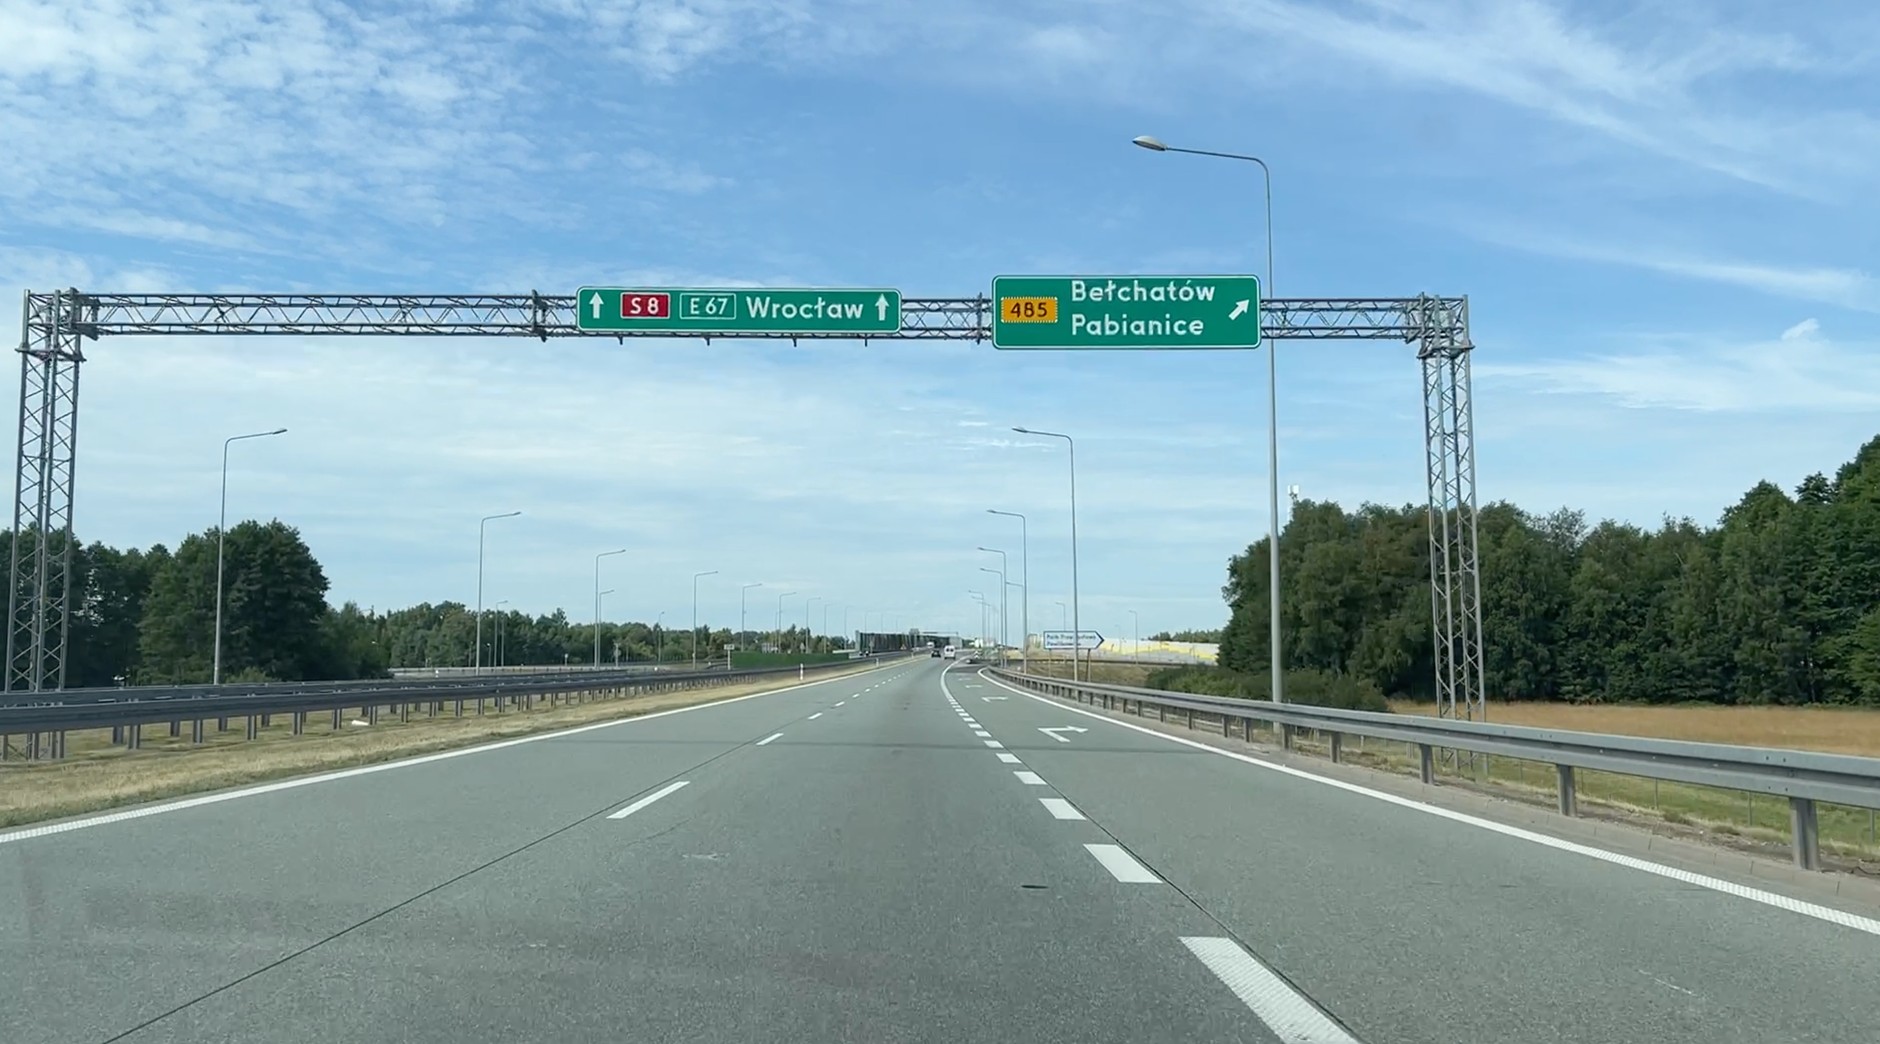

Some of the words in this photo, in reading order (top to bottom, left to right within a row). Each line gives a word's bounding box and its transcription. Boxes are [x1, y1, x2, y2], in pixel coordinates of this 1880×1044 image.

[1071, 279, 1216, 302] Bełchatów
[630, 297, 642, 314] S
[647, 297, 660, 314] 8
[690, 298, 700, 315] E
[705, 298, 728, 315] 67
[746, 296, 864, 320] Wrocław
[1010, 302, 1048, 318] 485
[1071, 313, 1205, 336] Pabianice
